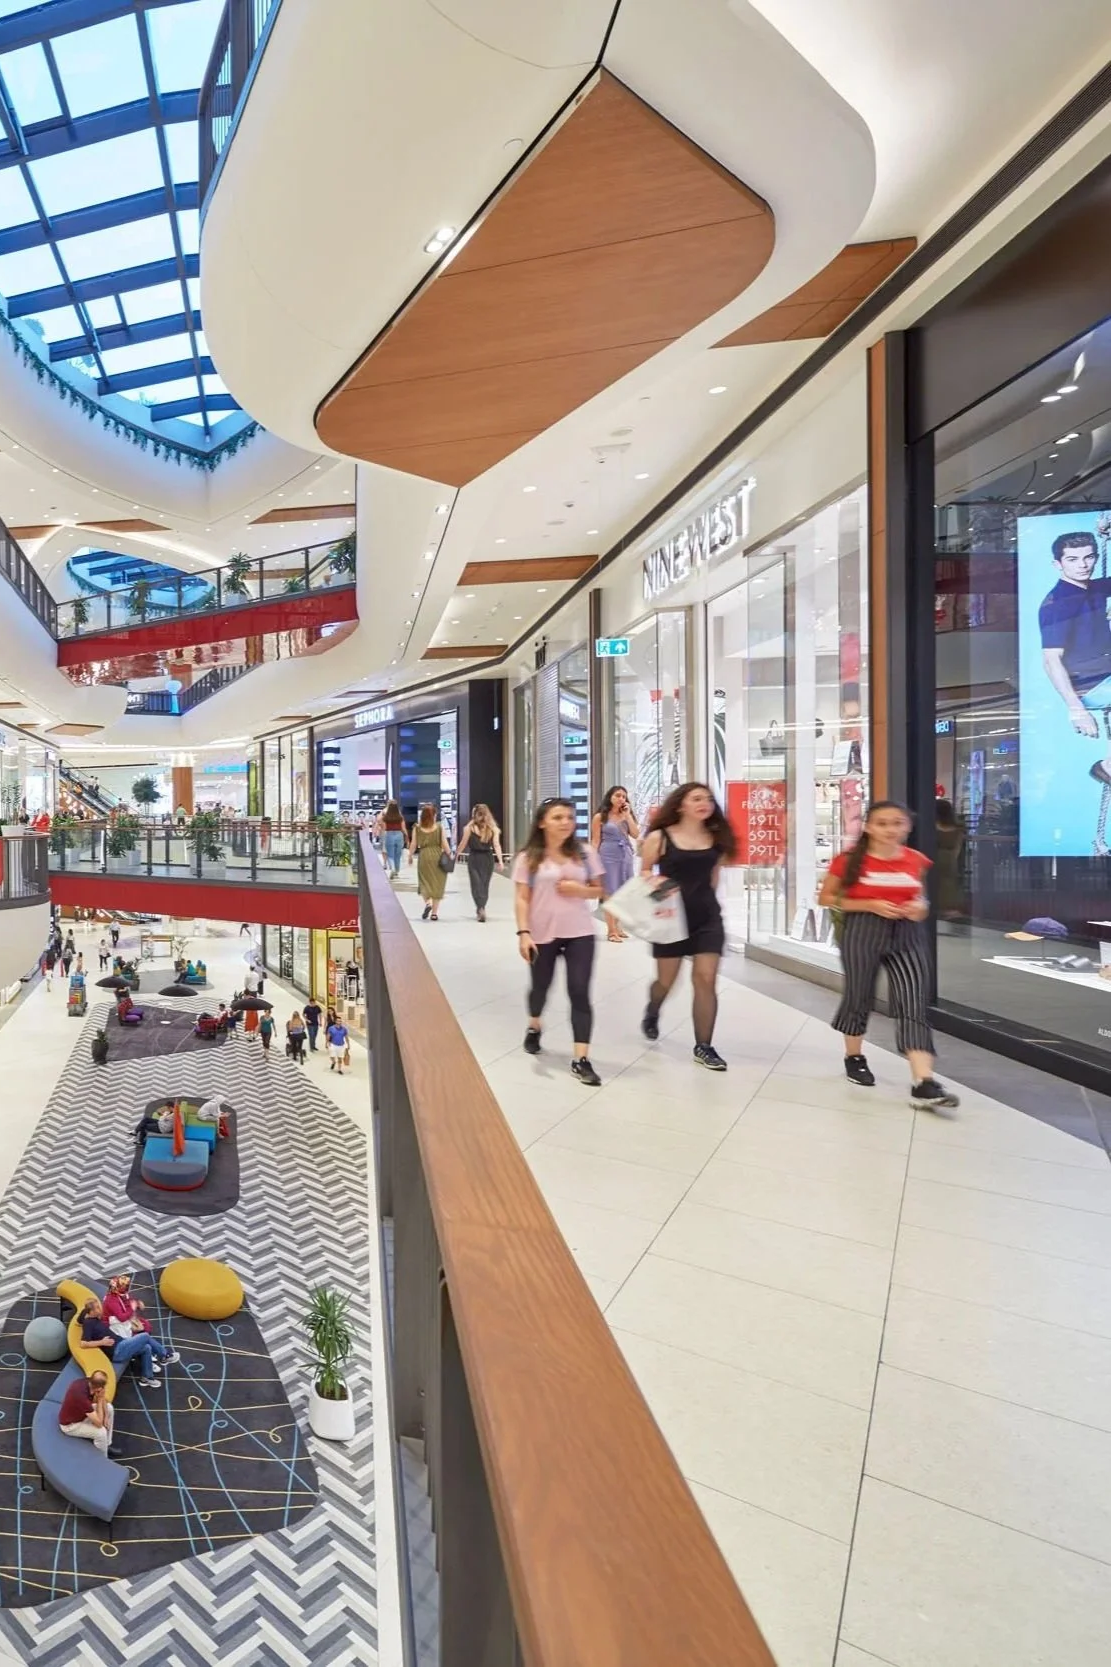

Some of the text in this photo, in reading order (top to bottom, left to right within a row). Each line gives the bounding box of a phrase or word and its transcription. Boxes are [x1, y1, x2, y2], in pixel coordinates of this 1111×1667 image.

[642, 476, 757, 601] NINE WEST
[354, 704, 394, 729] SEPHORA
